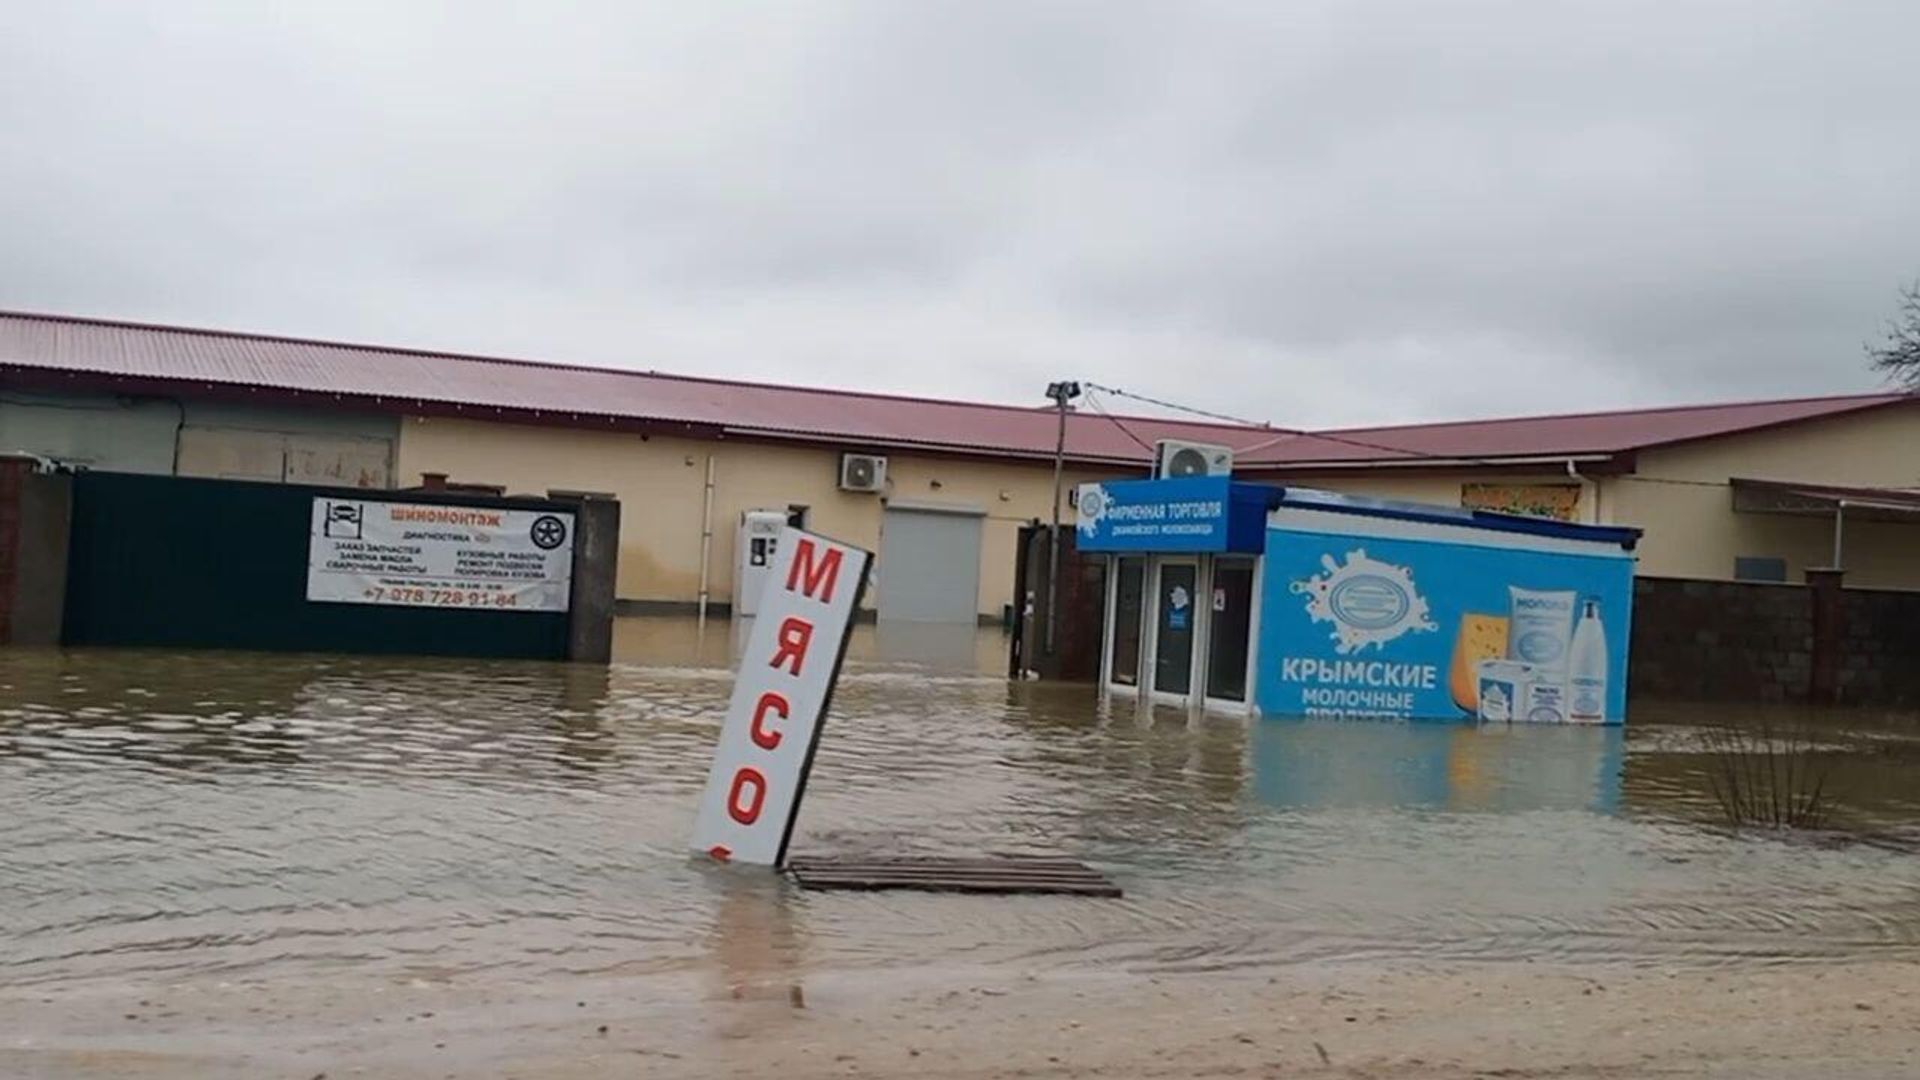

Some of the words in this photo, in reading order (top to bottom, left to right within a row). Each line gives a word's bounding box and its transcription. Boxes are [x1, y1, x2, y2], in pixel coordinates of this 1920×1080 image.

[1106, 504, 1166, 520] ФИРМЕННАЯ
[1168, 501, 1222, 519] ТОРГОВЛЯ
[402, 531, 471, 542] ДИАГНОСТИКА
[335, 542, 365, 551] ЗАКАЗ
[366, 543, 422, 555] ЗАПЧАСТЕЙ
[340, 551, 378, 561] ЗАМЕНА
[380, 554, 413, 563] МАСЛА
[457, 550, 504, 560] КУЗОВНЫЕ
[508, 552, 546, 561] РАБОТЫ
[326, 560, 385, 571] СВАРОЧНЫЕ
[387, 563, 428, 574] РАБОТЫ
[458, 559, 493, 568] РЕМОНТ
[496, 561, 544, 571] ПОДВЕСКИ
[454, 567, 510, 578] ПОЛИРОВКА
[511, 570, 546, 579] КУЗОВА
[363, 586, 385, 601] +7
[390, 587, 425, 602] 978
[430, 590, 464, 605] 728
[468, 591, 490, 606] 91
[495, 593, 518, 607] 84
[1281, 657, 1437, 689] КРЫМСКИЕ
[707, 537, 844, 861] МЯСО
[1302, 687, 1414, 710] МОЛОЧНЫЕ
